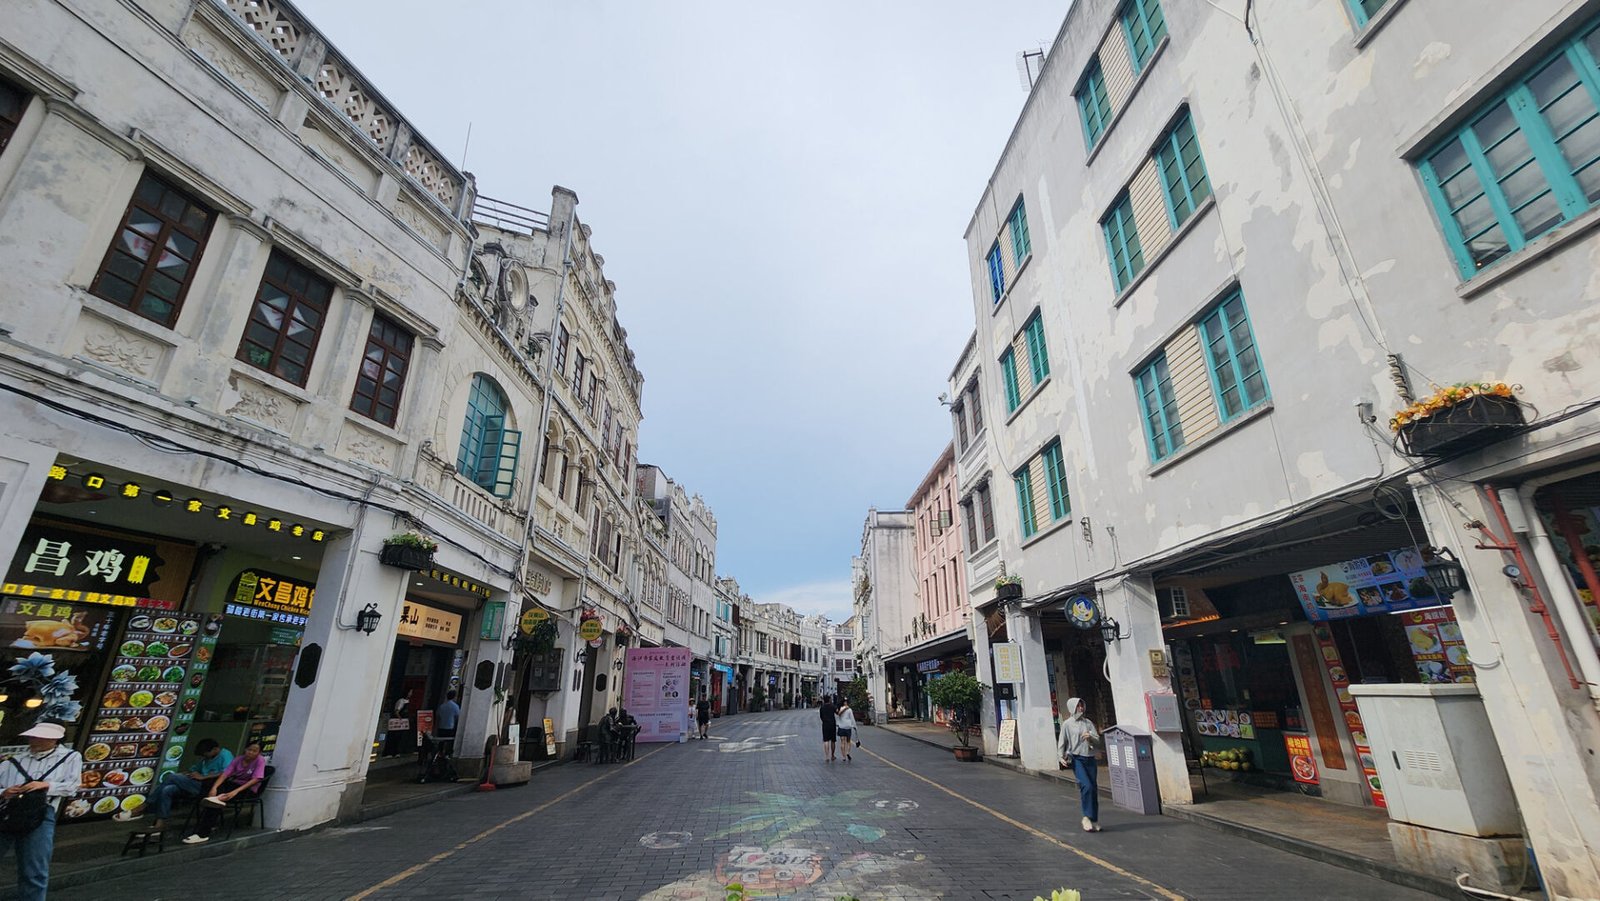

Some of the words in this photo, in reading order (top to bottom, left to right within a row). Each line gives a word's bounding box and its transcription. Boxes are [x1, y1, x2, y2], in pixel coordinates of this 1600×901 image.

[24, 537, 126, 583] 昌鸡
[17, 602, 73, 619] 文昌鸡
